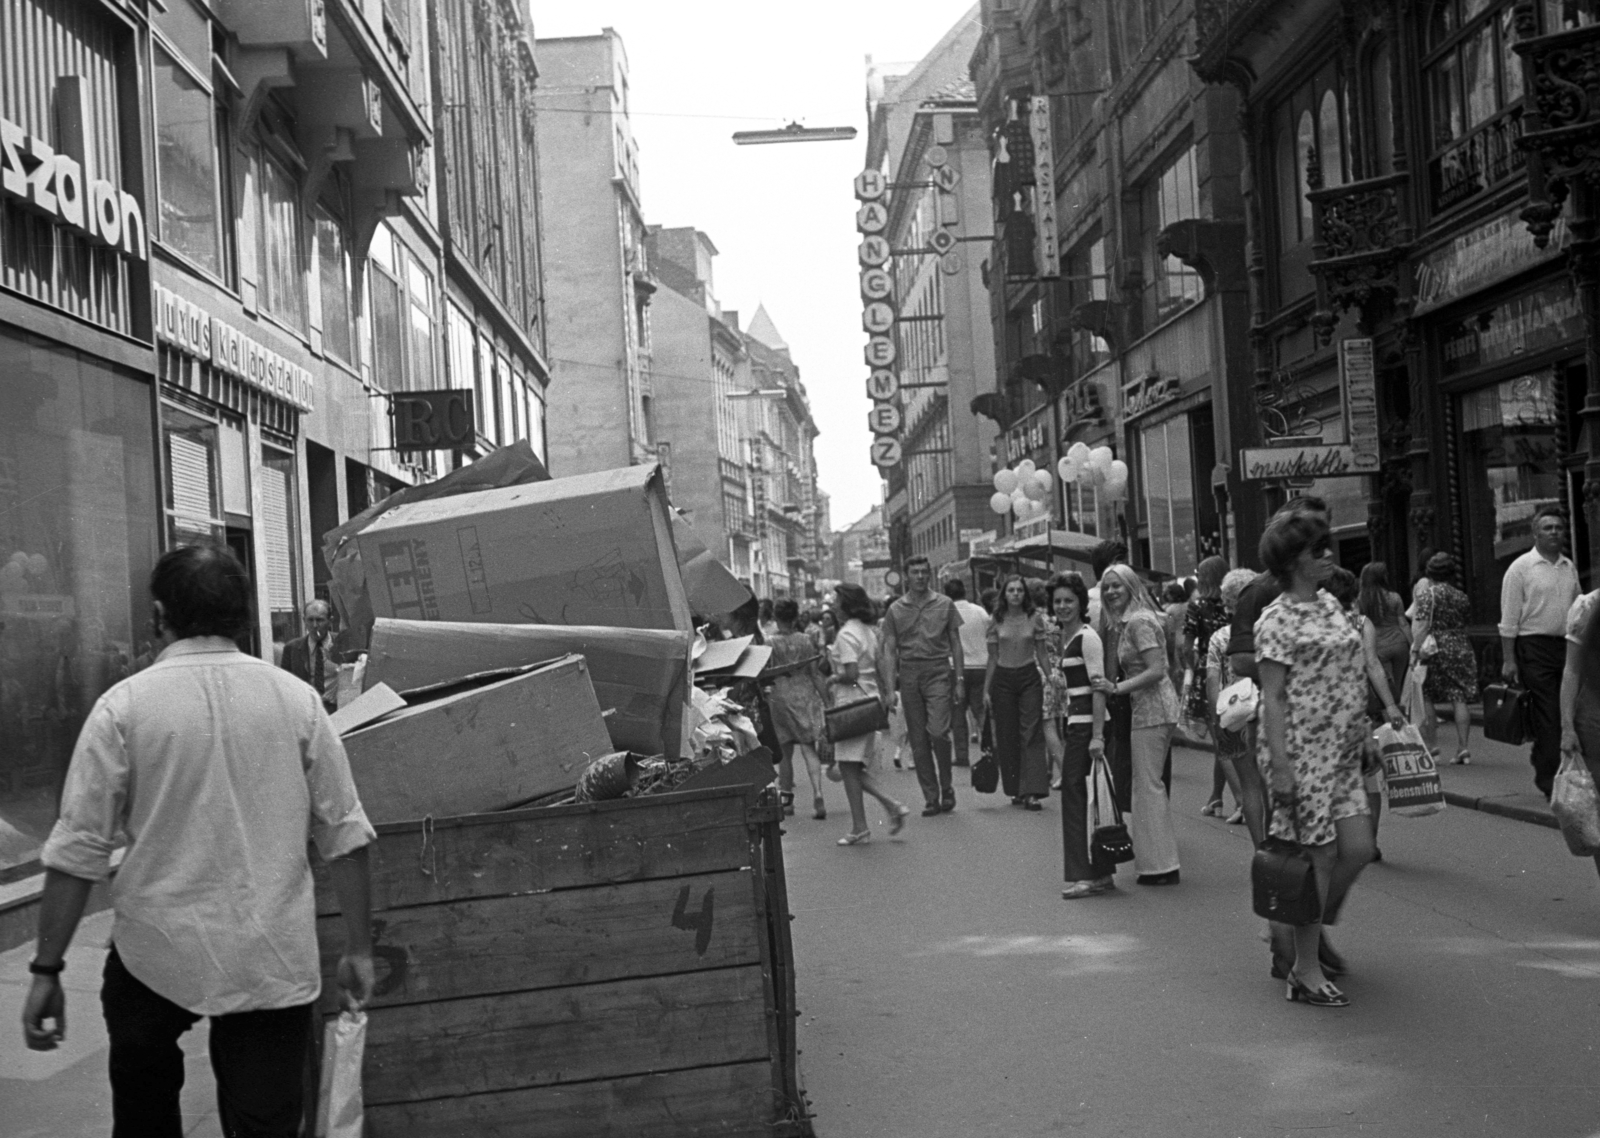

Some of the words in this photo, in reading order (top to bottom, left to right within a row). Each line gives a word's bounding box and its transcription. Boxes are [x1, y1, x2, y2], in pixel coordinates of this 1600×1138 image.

[0, 77, 147, 261] szalon
[154, 288, 211, 352] luxus
[218, 325, 313, 408] kalapszalon
[859, 174, 897, 463] HANGLEMEZ
[670, 884, 715, 957] 4
